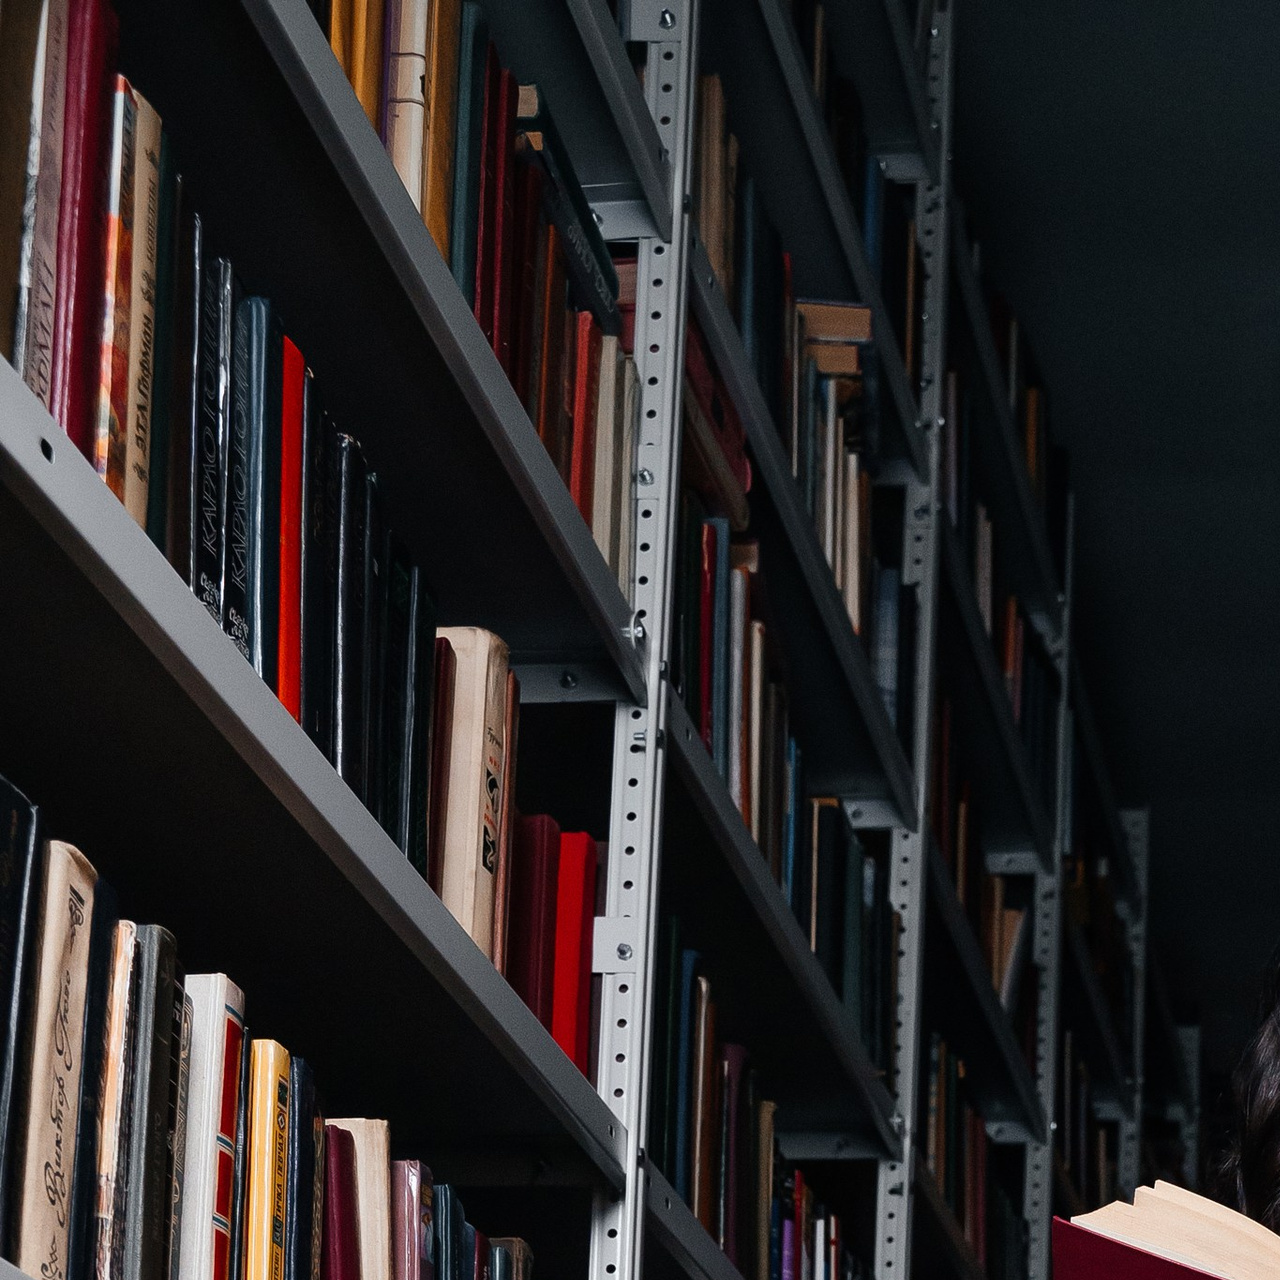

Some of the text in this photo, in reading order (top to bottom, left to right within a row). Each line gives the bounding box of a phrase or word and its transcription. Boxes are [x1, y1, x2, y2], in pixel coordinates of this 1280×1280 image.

[137, 314, 153, 396] Гофман
[202, 426, 217, 558] КАРЛО
[232, 465, 247, 593] КАРЛО
[44, 970, 73, 1228] Виктор Гюго
